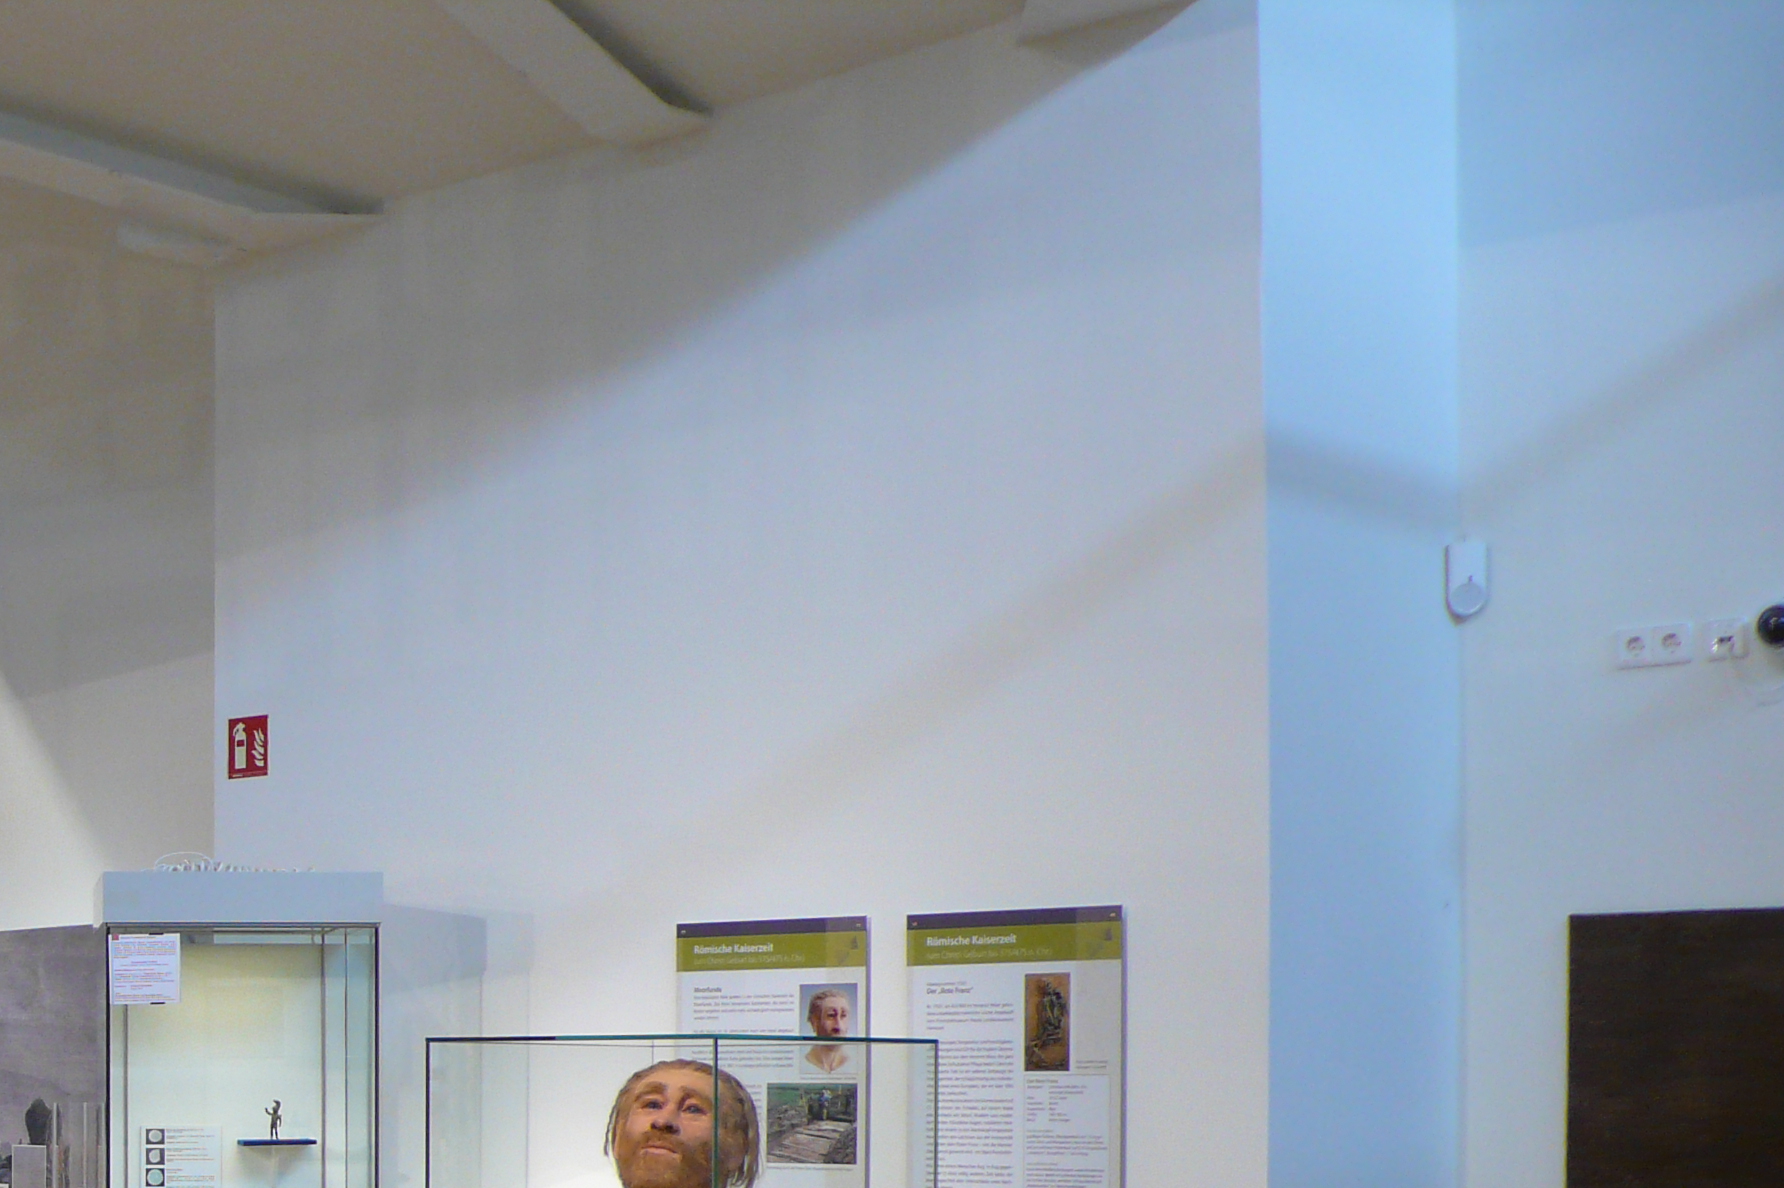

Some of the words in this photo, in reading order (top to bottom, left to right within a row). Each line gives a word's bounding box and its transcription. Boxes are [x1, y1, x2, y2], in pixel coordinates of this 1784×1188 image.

[926, 936, 970, 946] Römische
[972, 933, 1017, 945] Kaiserzeit
[693, 944, 732, 954] Römische
[734, 942, 774, 953] Kaiserzeit
